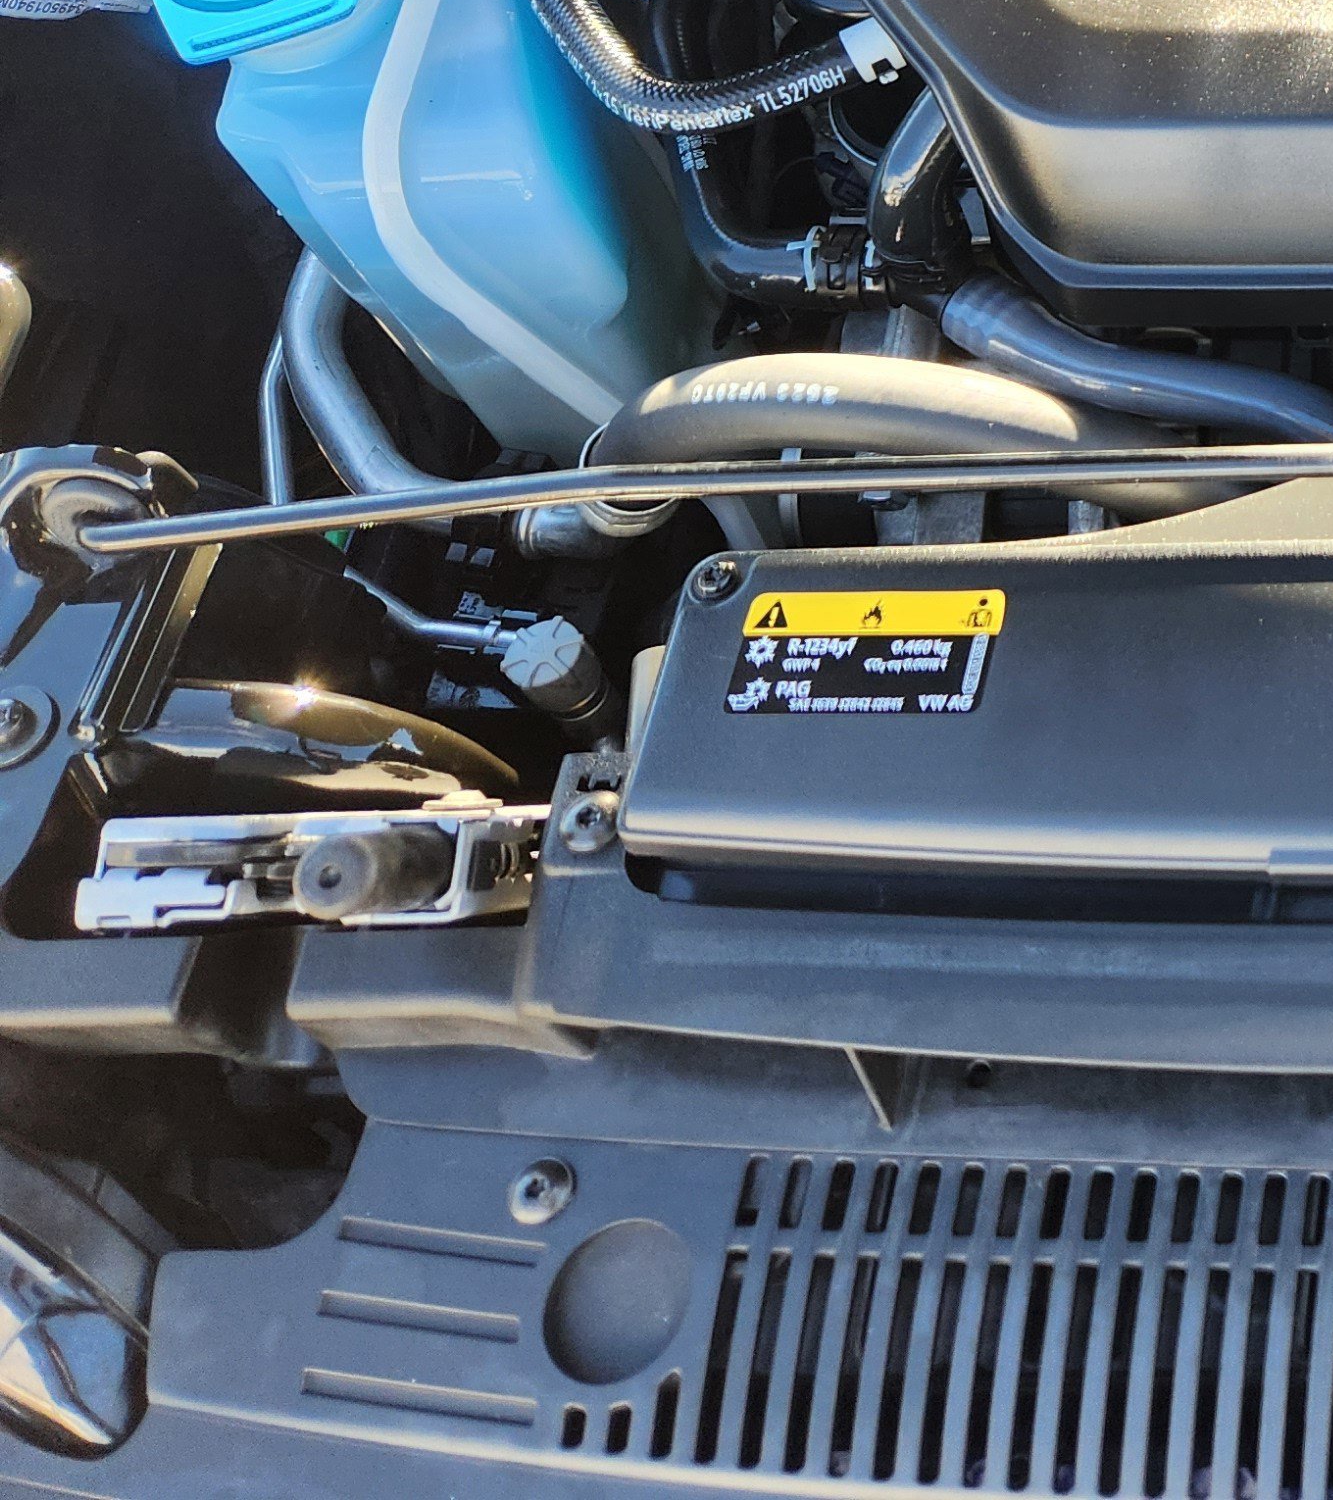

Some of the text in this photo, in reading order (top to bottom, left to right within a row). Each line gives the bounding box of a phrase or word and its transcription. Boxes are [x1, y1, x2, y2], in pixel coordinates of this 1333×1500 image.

[622, 102, 756, 132] VeriPentaflex
[755, 64, 848, 114] TL52706H
[784, 637, 858, 659] R-1234yf
[931, 639, 953, 657] kg
[780, 657, 811, 672] GWP
[773, 680, 812, 698] PAG
[914, 694, 974, 710] VW AG
